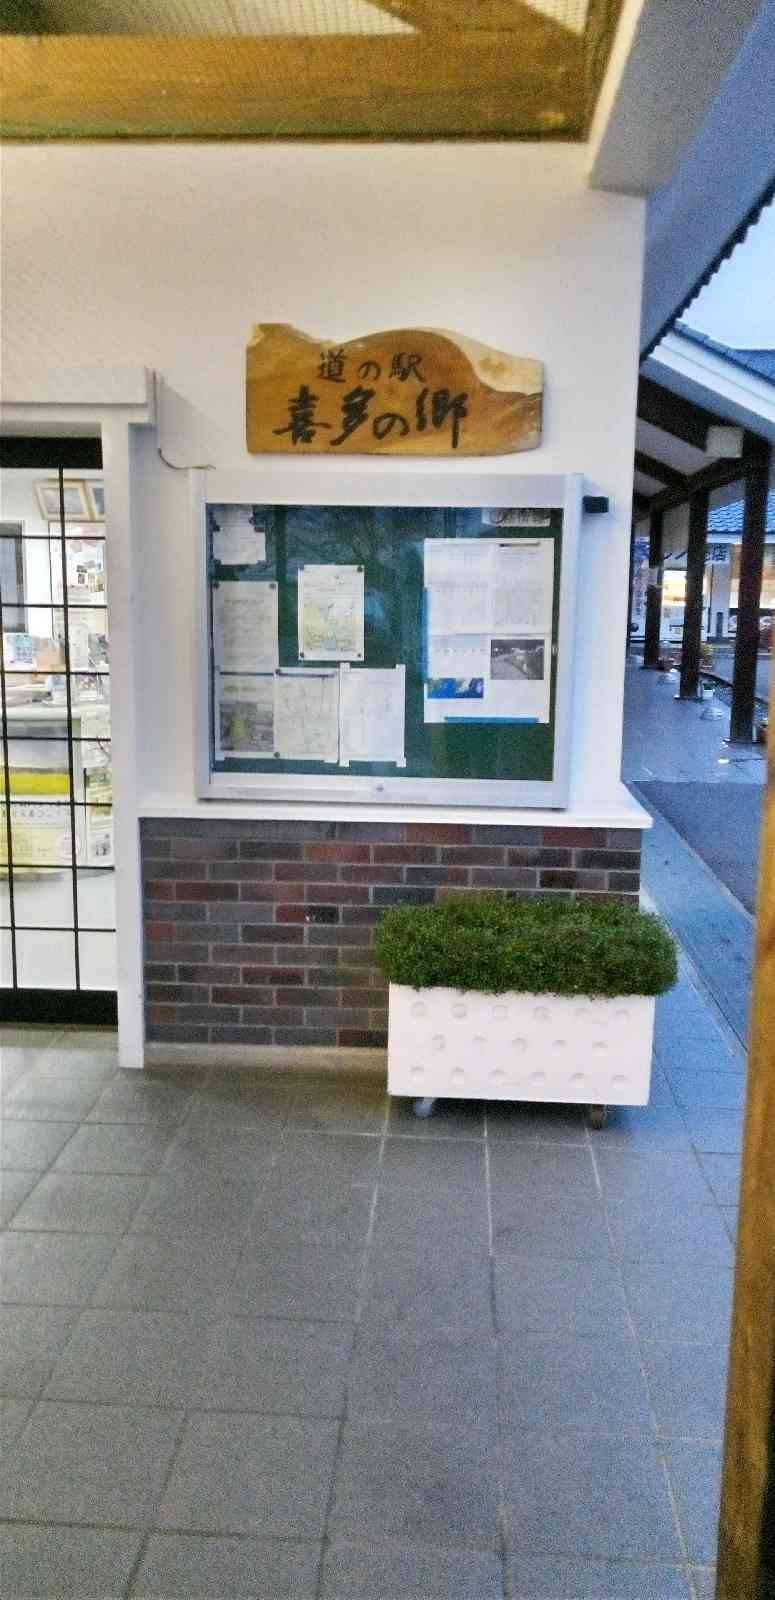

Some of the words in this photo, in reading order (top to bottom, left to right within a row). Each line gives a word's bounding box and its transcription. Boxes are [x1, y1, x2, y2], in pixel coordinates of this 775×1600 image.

[317, 349, 426, 382] 道の駅
[273, 385, 469, 449] 喜多の郷
